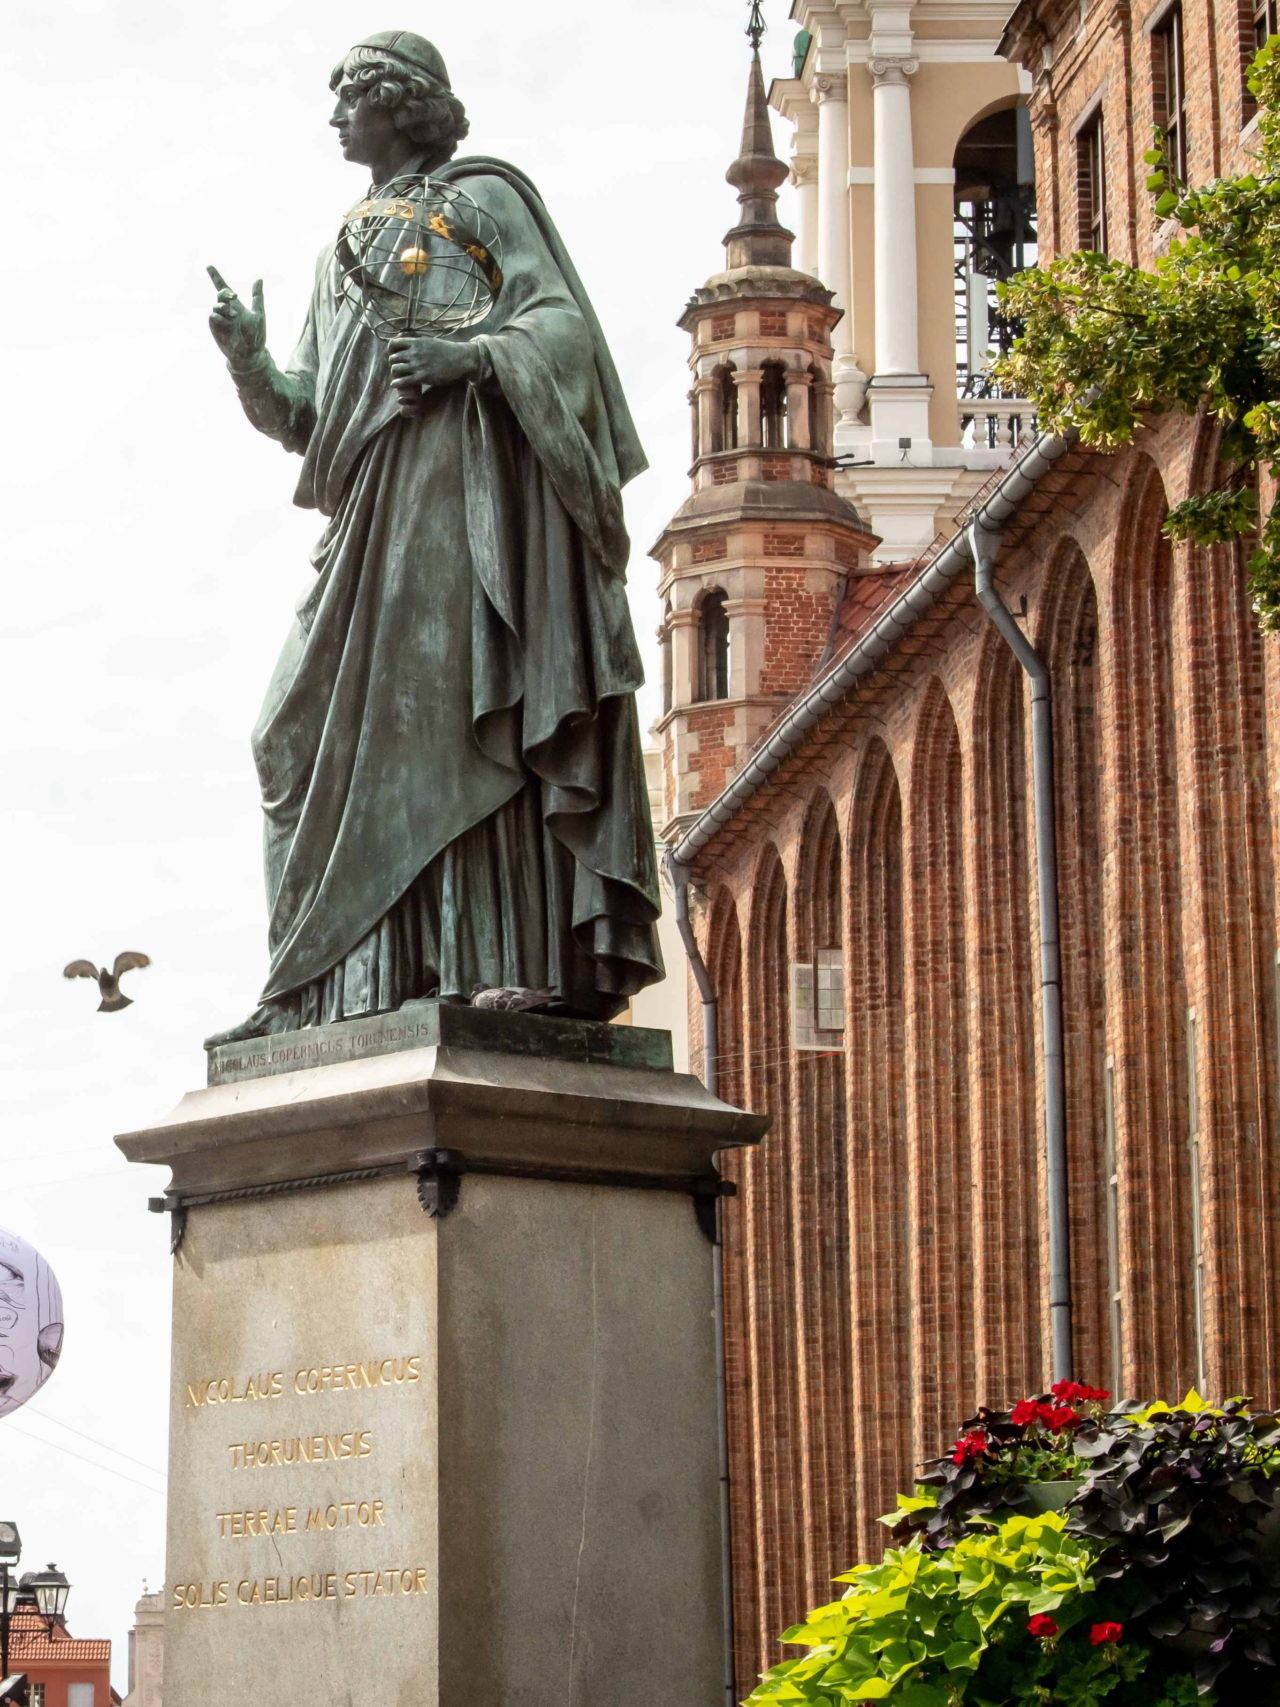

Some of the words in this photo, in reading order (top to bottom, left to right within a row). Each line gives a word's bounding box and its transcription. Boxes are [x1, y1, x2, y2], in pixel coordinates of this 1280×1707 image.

[185, 1372, 284, 1407] NICOLAUS
[294, 1356, 421, 1396] COPERNICUS
[228, 1431, 373, 1470] THORUNENSIS
[216, 1507, 298, 1539] TERRAE
[305, 1500, 386, 1532] MOTOR
[173, 1581, 229, 1610] SOLIS
[236, 1573, 338, 1606] CAELIQUE
[344, 1567, 429, 1599] STATOR
